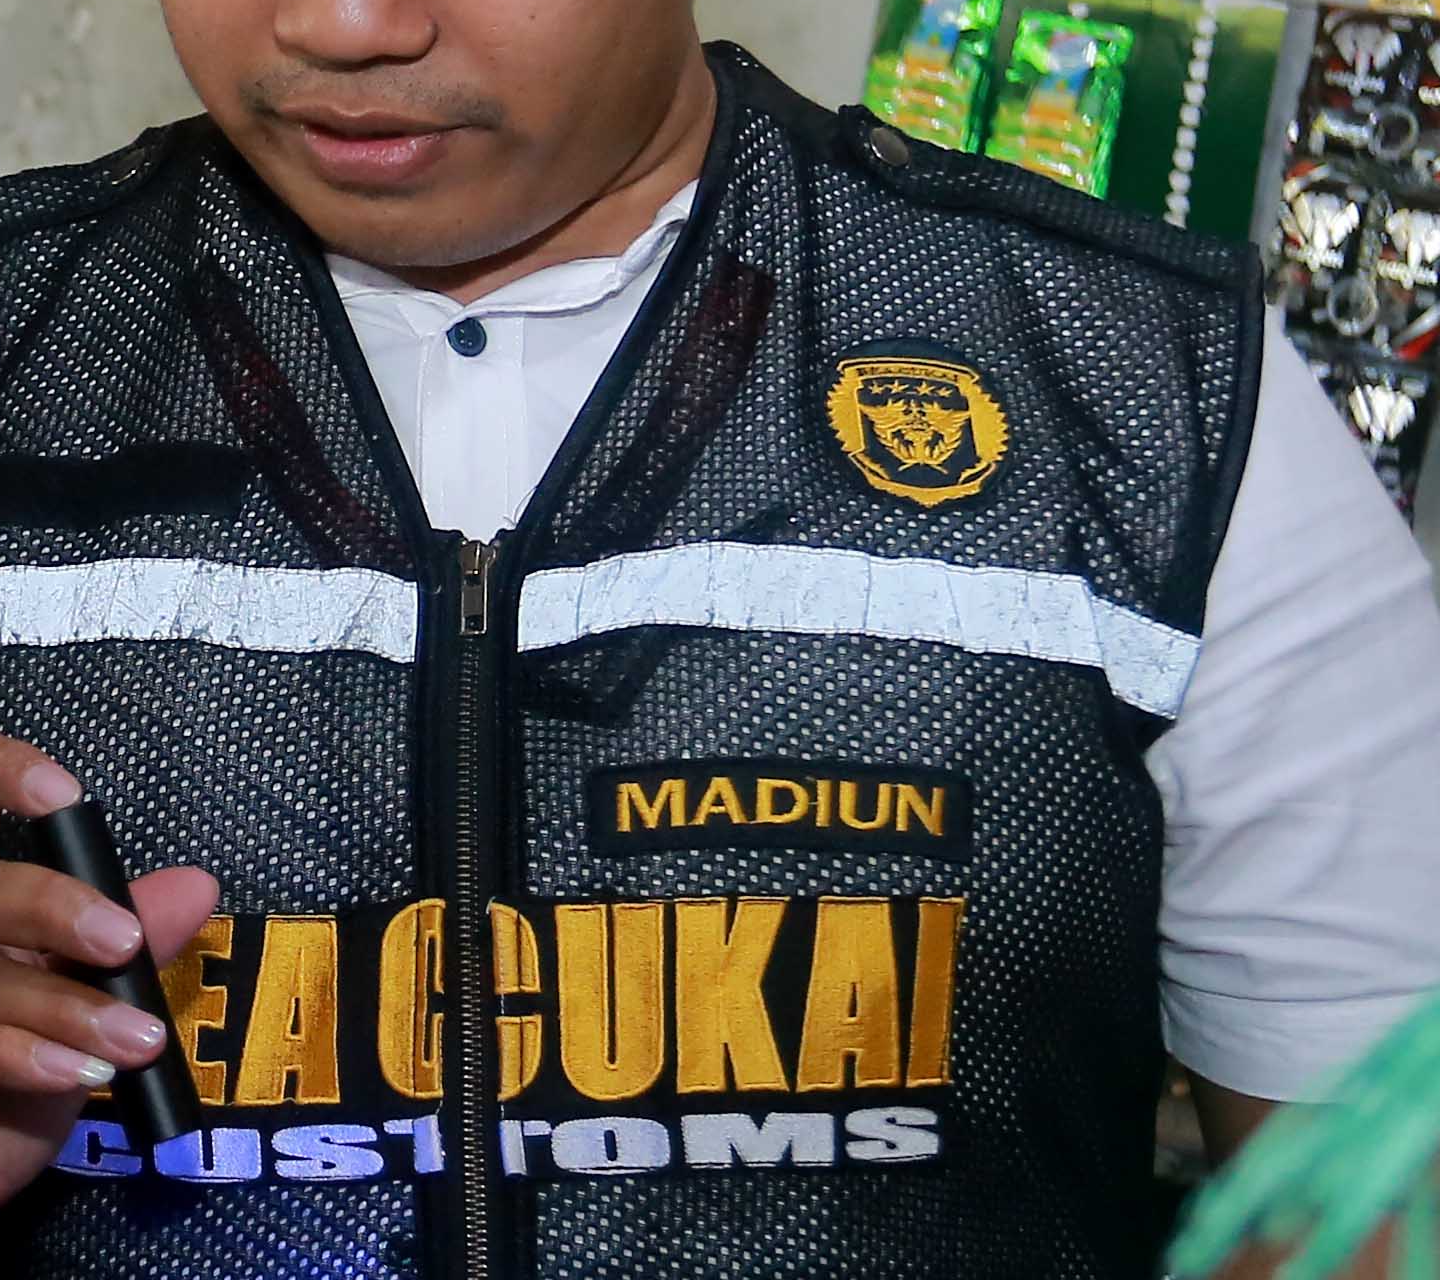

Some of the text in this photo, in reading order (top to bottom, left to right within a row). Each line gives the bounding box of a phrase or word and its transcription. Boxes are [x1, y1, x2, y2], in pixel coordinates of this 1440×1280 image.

[616, 775, 945, 838] MADIUN
[87, 896, 967, 1106] EA CUKAI
[52, 1107, 940, 1183] CUSTOMS
